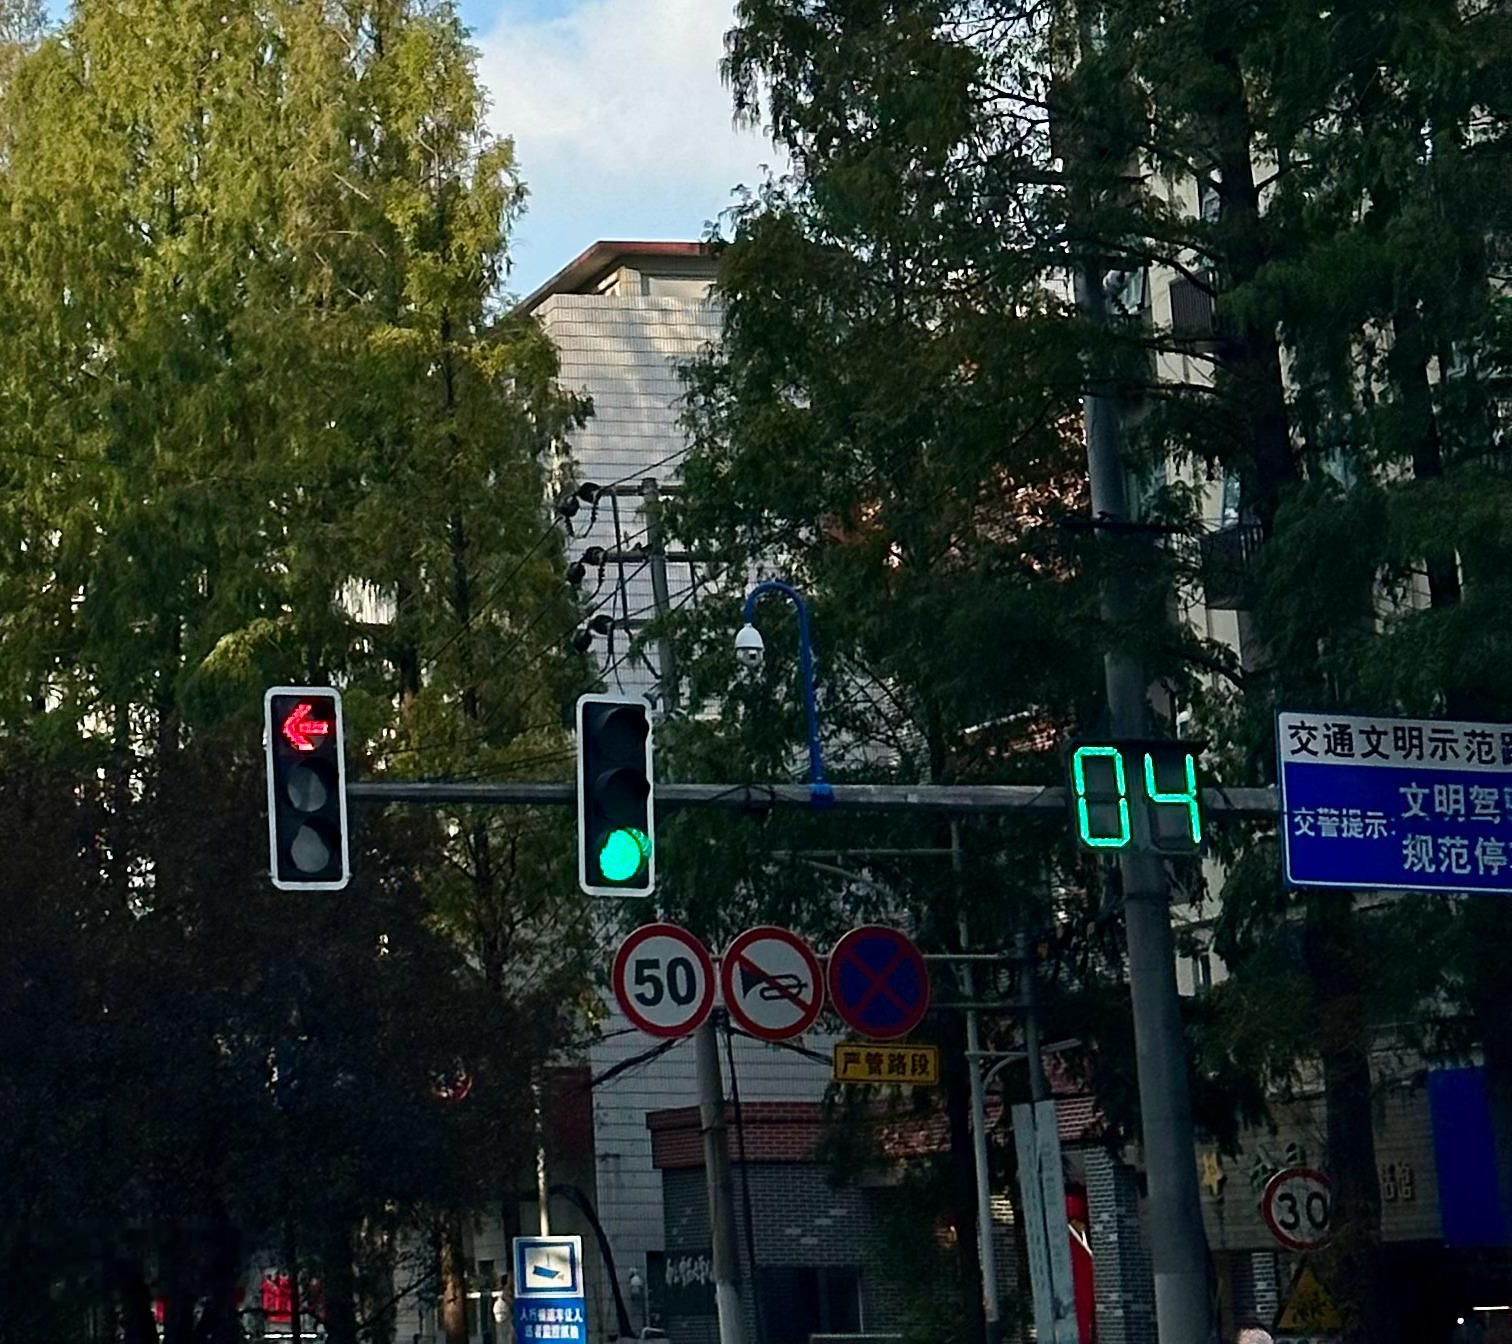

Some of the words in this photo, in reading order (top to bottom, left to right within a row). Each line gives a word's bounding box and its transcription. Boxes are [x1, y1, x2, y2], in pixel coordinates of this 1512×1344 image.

[1074, 747, 1201, 847] 04
[1402, 833, 1512, 875] 规范停
[634, 957, 696, 1006] 50
[842, 1052, 929, 1076] 严管路段
[1278, 1192, 1328, 1230] 30
